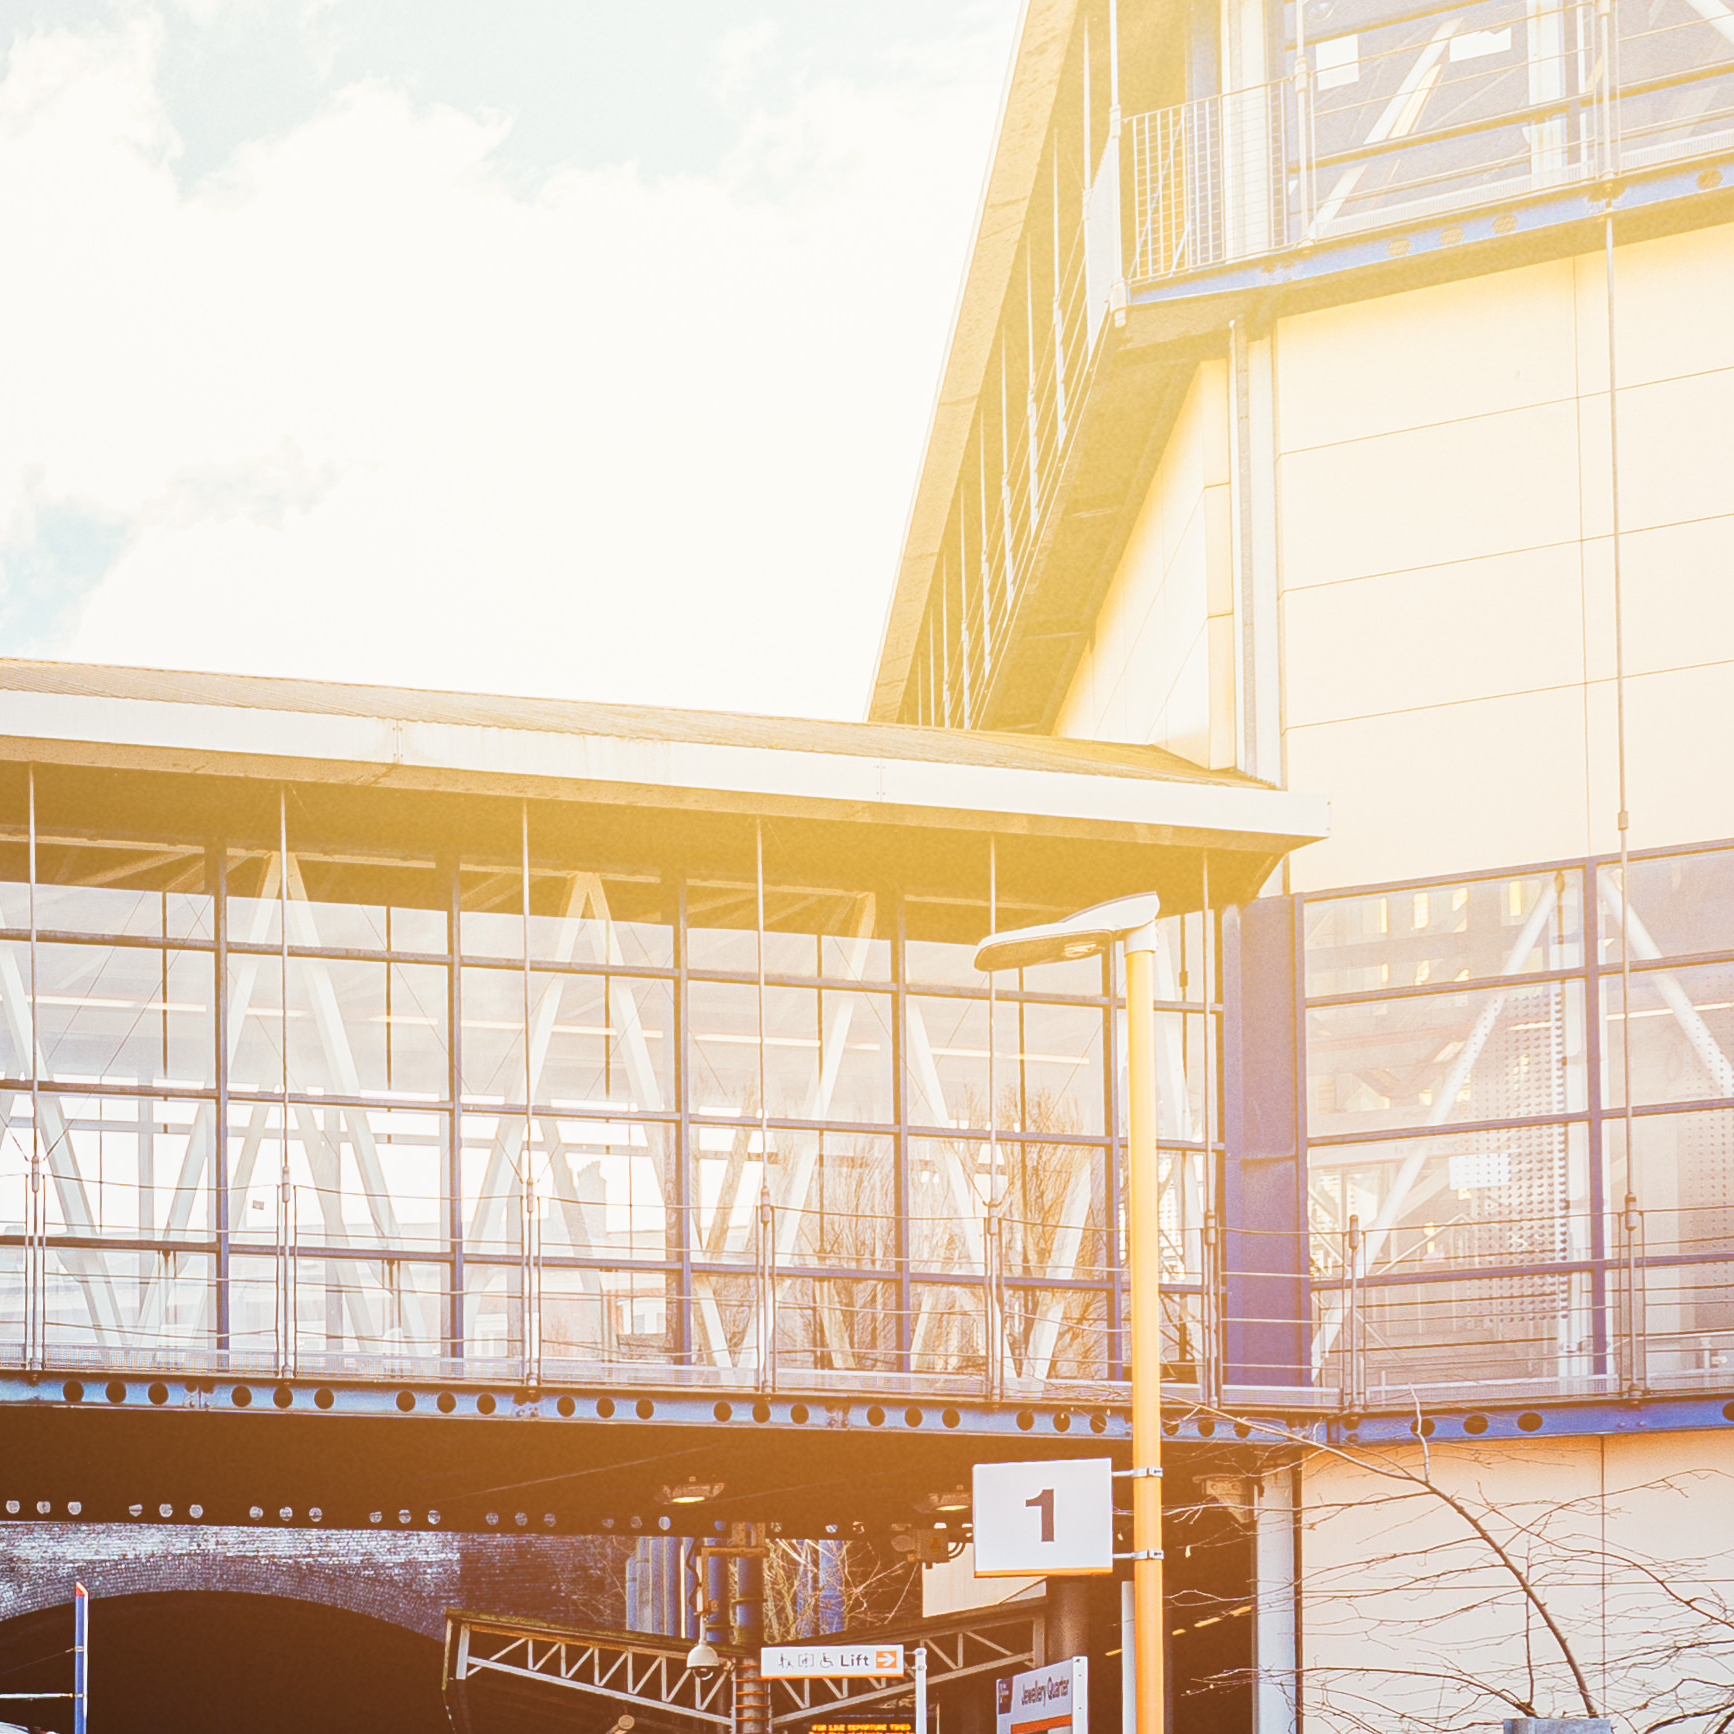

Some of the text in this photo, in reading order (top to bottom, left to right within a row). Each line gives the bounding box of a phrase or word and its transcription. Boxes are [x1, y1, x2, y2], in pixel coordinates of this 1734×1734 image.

[1025, 1488, 1055, 1542] 1
[840, 1653, 870, 1667] Lift
[1021, 1679, 1046, 1707] Jewellery
[1047, 1676, 1070, 1701] Quarter
